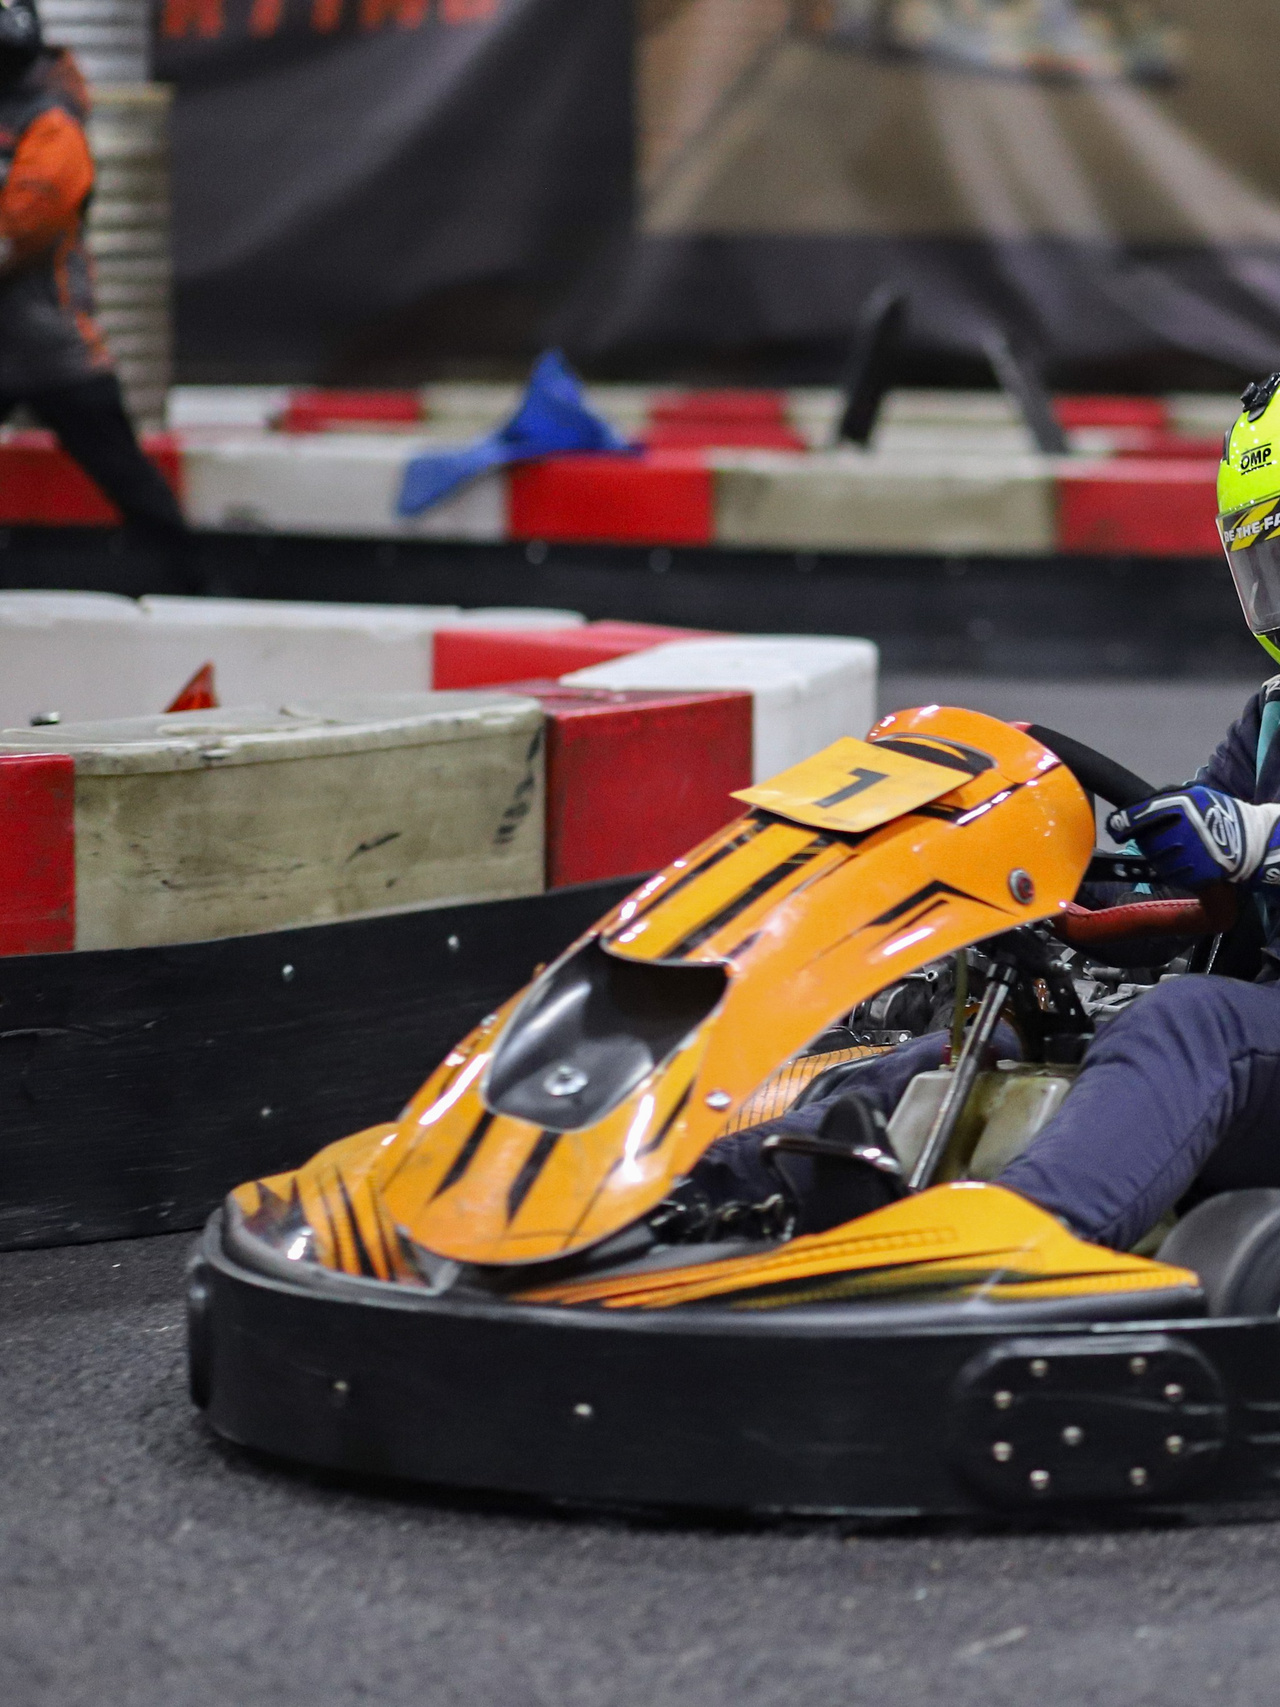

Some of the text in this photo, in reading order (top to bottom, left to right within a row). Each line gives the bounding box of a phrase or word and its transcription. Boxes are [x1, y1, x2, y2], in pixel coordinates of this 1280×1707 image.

[1240, 447, 1272, 470] OMP
[1223, 529, 1236, 543] BE
[1236, 521, 1262, 540] THE
[812, 767, 890, 809] 1
